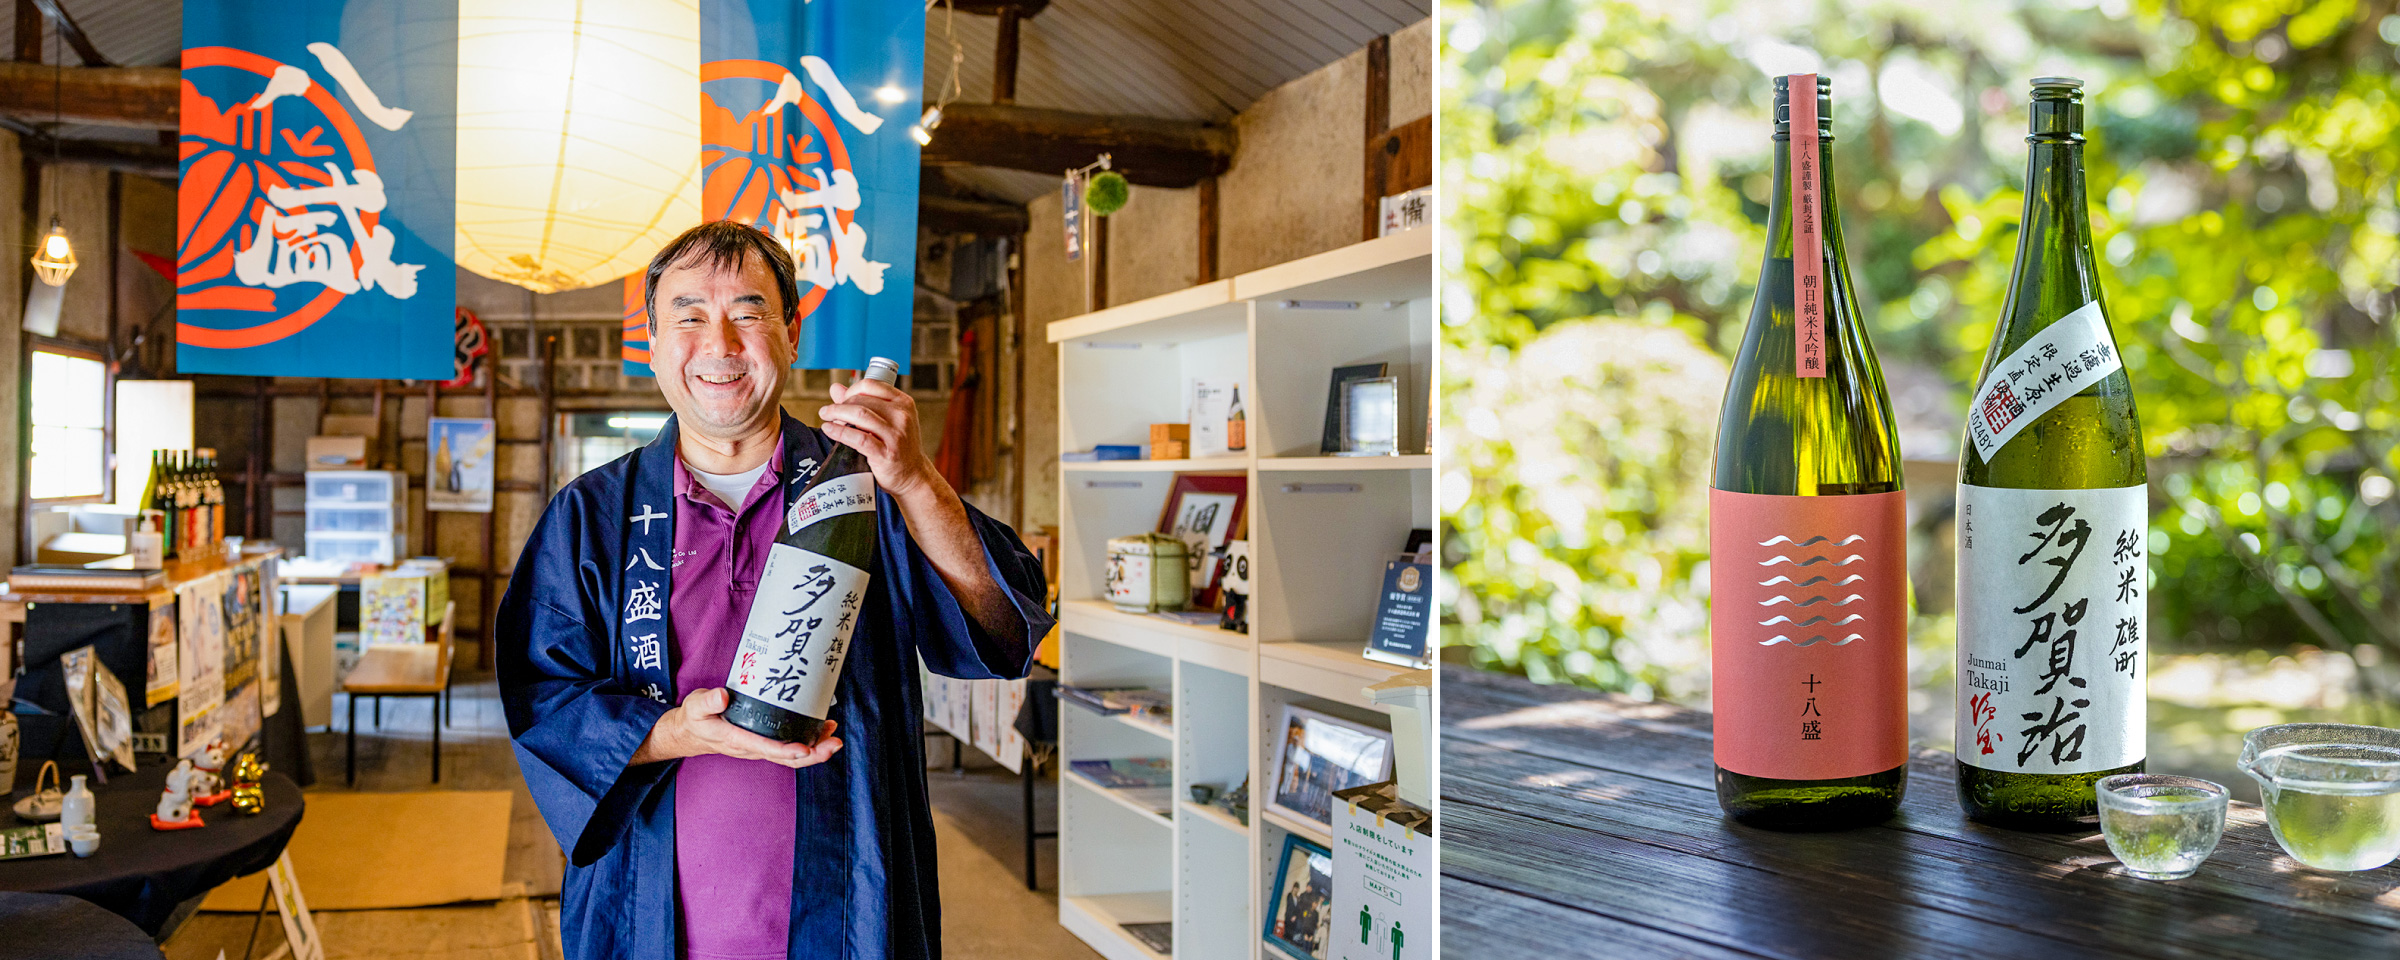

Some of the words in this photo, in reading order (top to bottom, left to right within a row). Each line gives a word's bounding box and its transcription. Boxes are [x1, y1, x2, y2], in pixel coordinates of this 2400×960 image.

[233, 42, 426, 299] 八盛
[1803, 275, 1820, 370] 朝日純米大吟醸
[1970, 408, 1994, 452] 2024BY
[1964, 503, 1974, 550] 日本酒
[2113, 528, 2141, 604] 純米
[759, 563, 836, 702] 多賀治
[836, 590, 859, 631] 純米
[2013, 502, 2092, 767] 多賀治
[1967, 653, 2007, 671] Junmai
[2109, 615, 2140, 680] 雄町
[1801, 673, 1822, 741] 十八盛
[1967, 669, 2010, 695] Takaji
